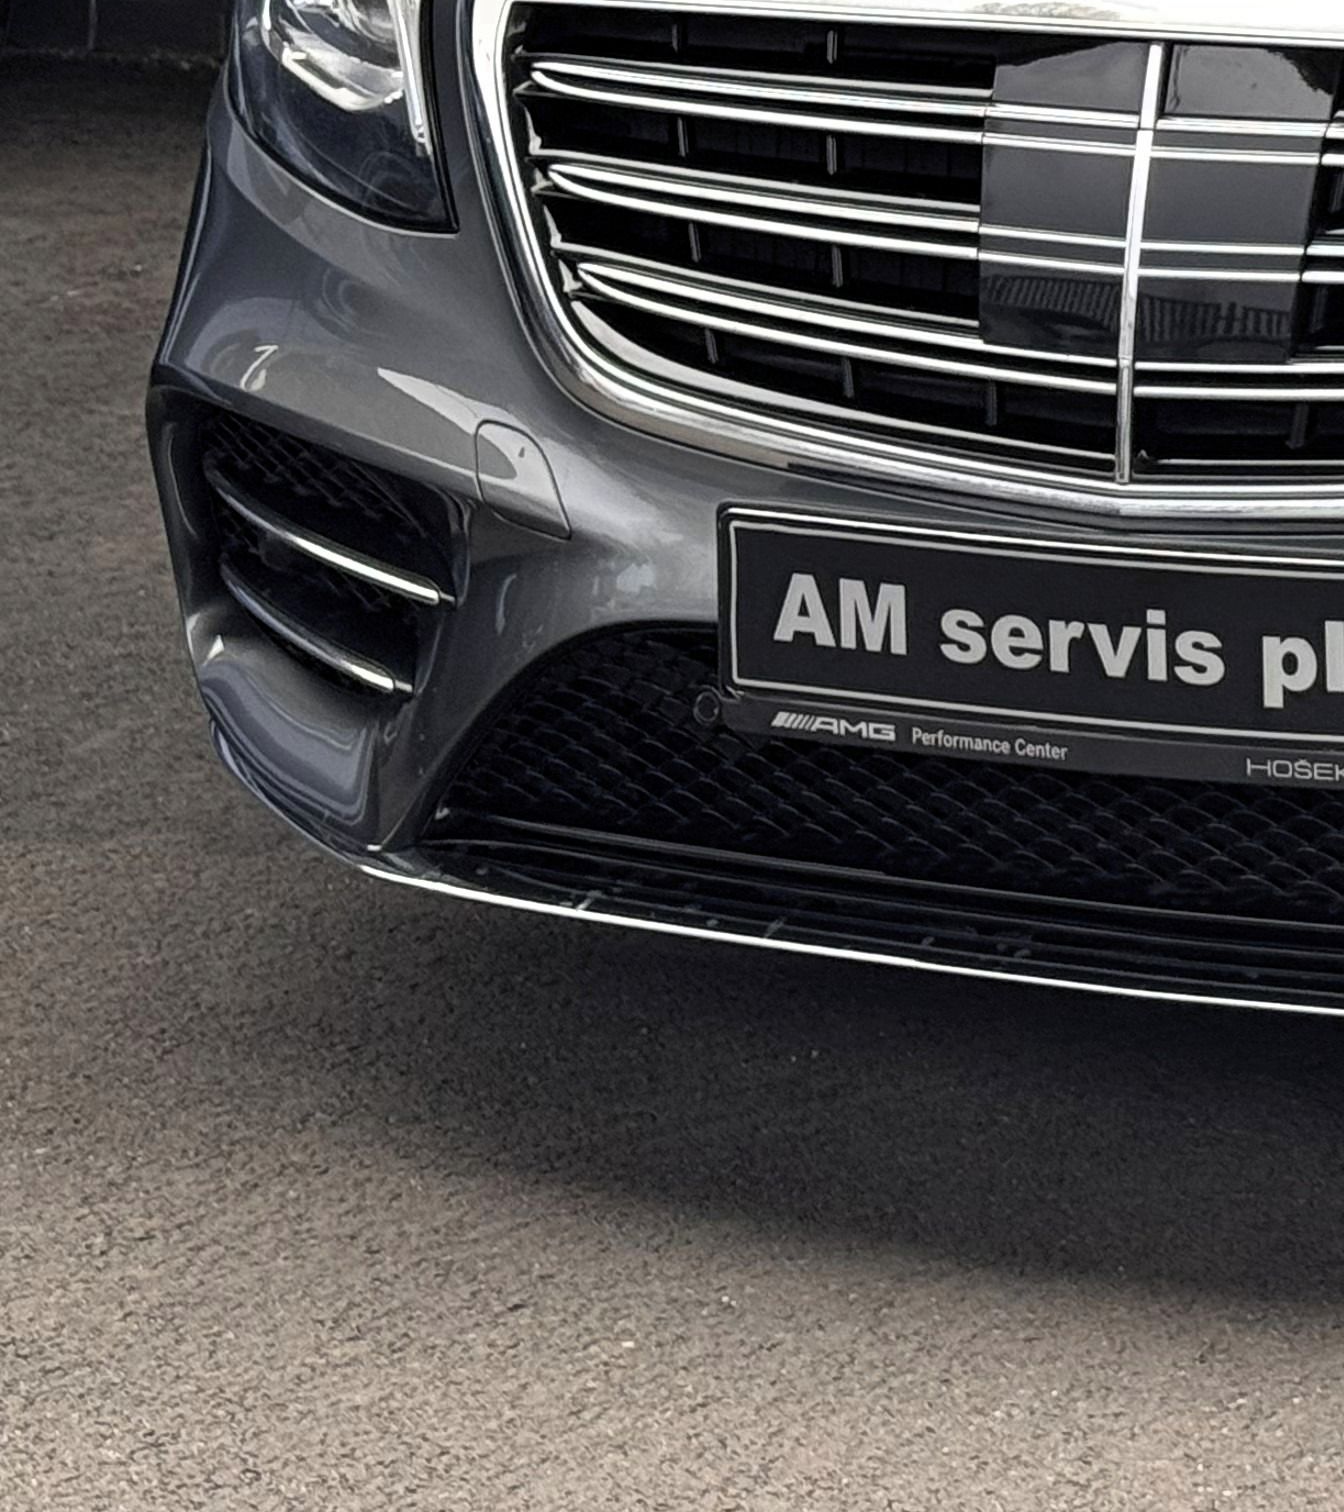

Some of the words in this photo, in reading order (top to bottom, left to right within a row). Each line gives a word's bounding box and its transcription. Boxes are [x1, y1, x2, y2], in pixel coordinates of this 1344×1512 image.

[773, 572, 909, 656] AM
[939, 608, 1226, 686] servis
[805, 714, 896, 742] AMG
[912, 726, 1011, 755] Performance
[1014, 738, 1068, 761] Center
